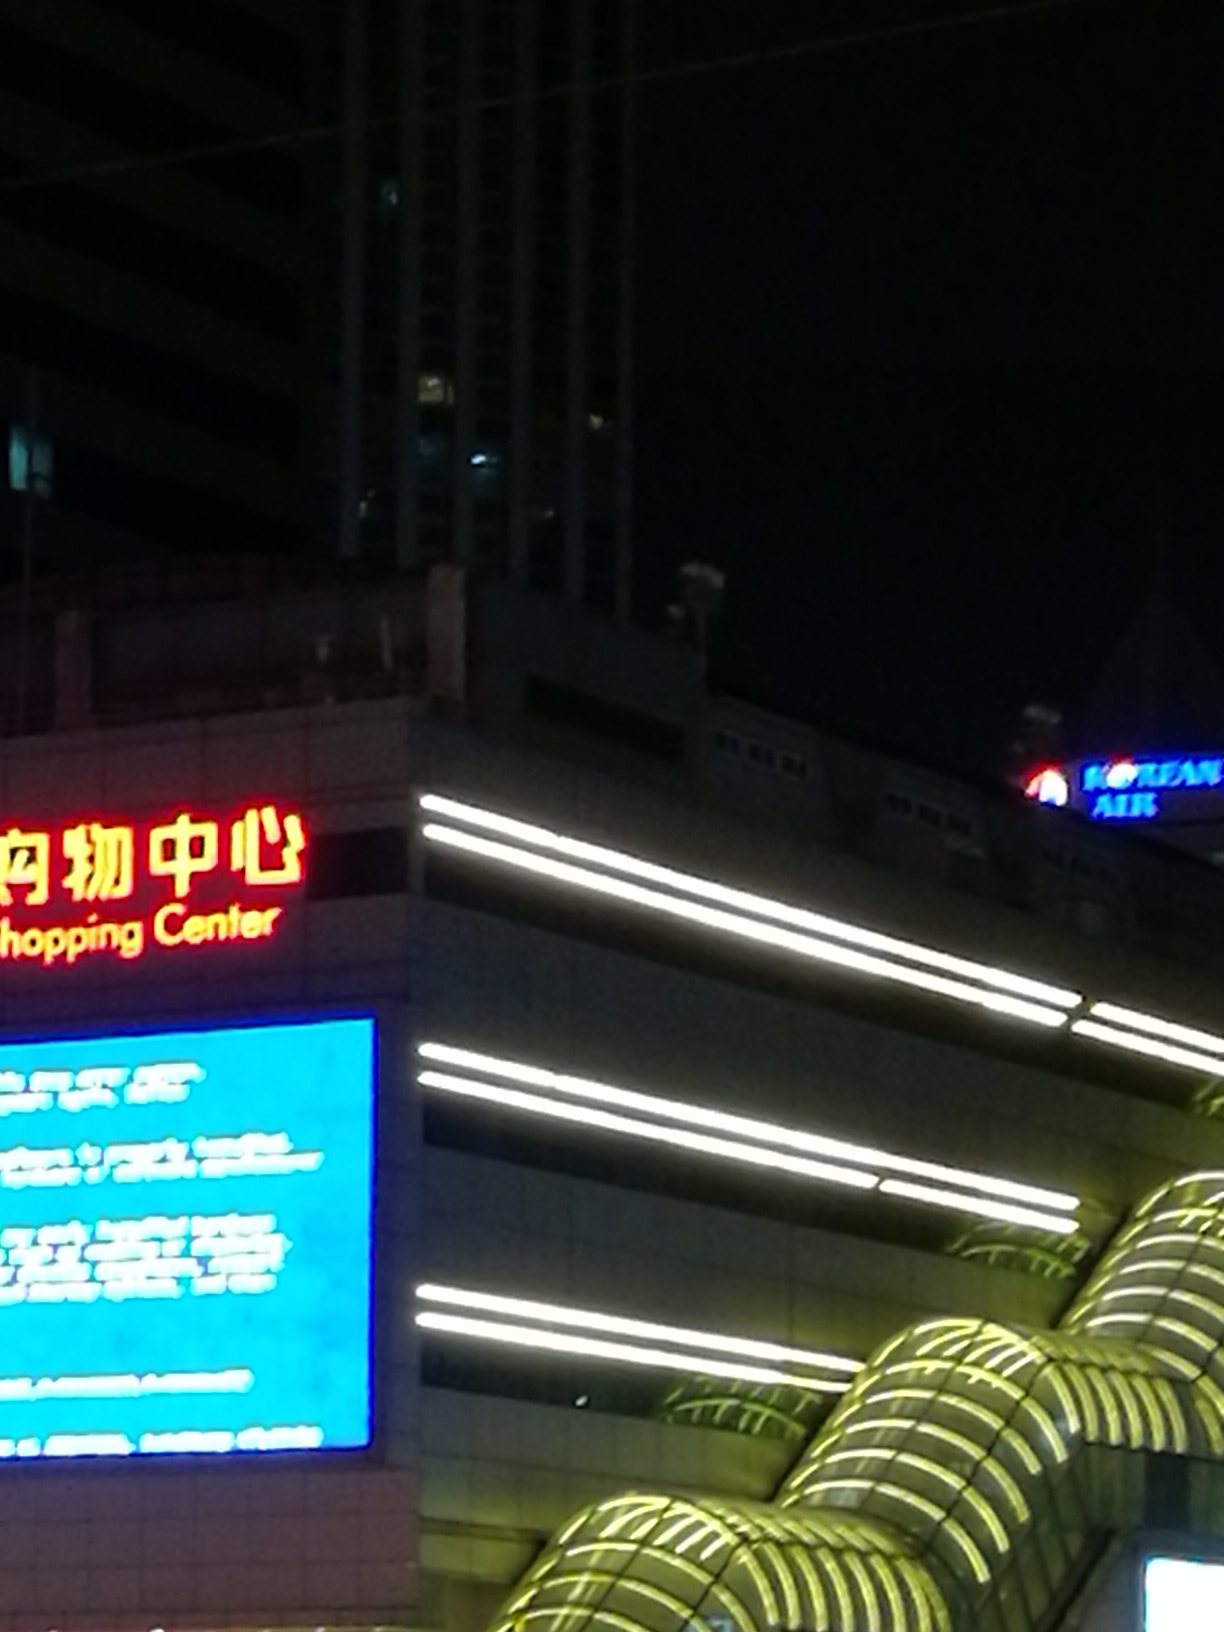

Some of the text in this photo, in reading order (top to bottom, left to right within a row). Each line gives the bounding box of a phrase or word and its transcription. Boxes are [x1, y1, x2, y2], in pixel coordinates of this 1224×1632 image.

[1082, 757, 1223, 791] KOREAN
[1091, 791, 1160, 819] AIR
[153, 903, 282, 946] Center
